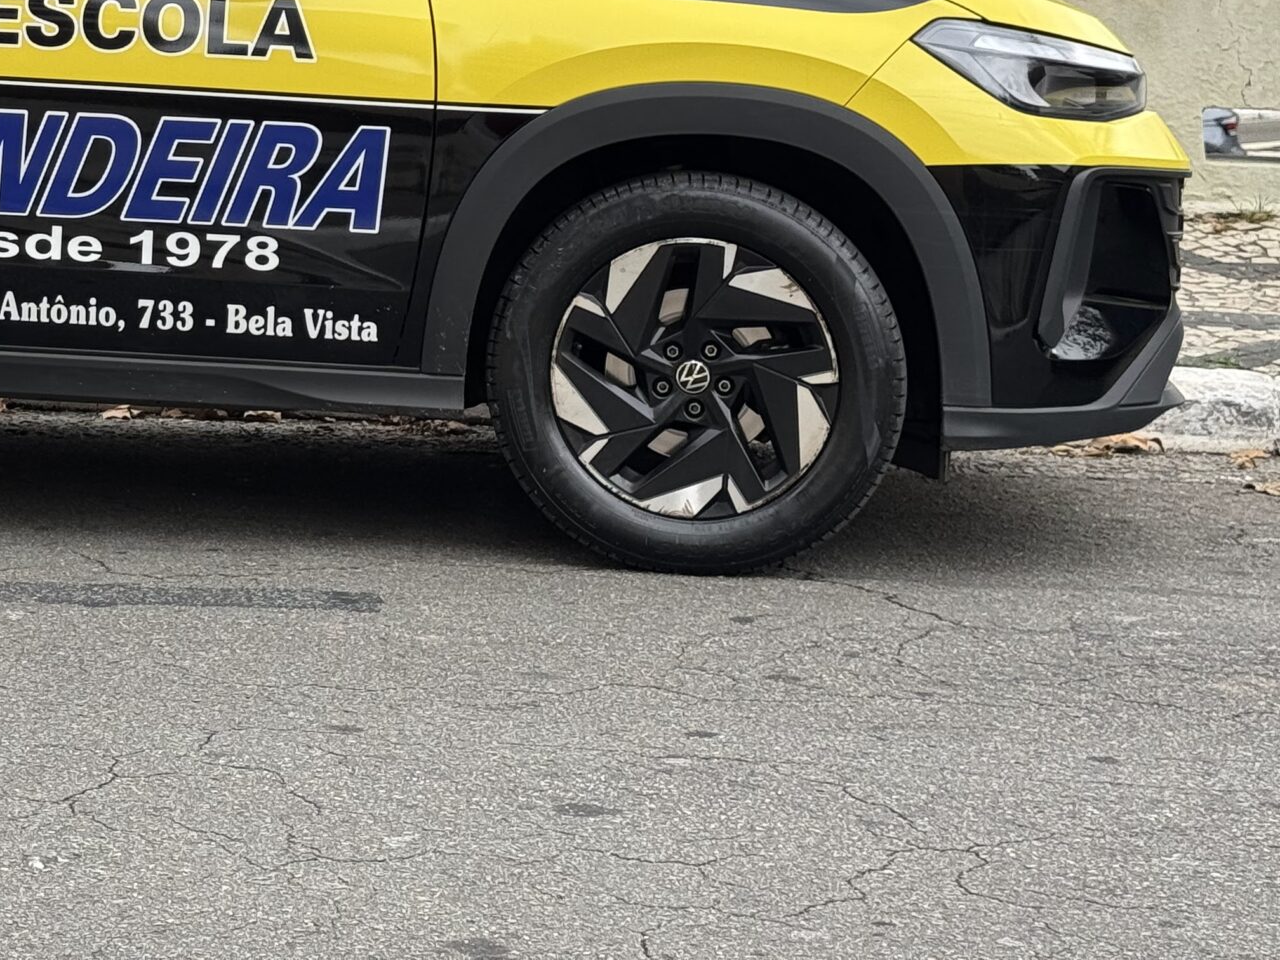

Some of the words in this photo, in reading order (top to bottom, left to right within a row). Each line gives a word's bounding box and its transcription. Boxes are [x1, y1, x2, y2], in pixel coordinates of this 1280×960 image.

[129, 229, 280, 271] 1978
[137, 299, 194, 332] 733
[226, 304, 293, 337] Bela
[303, 308, 378, 342] Vista
